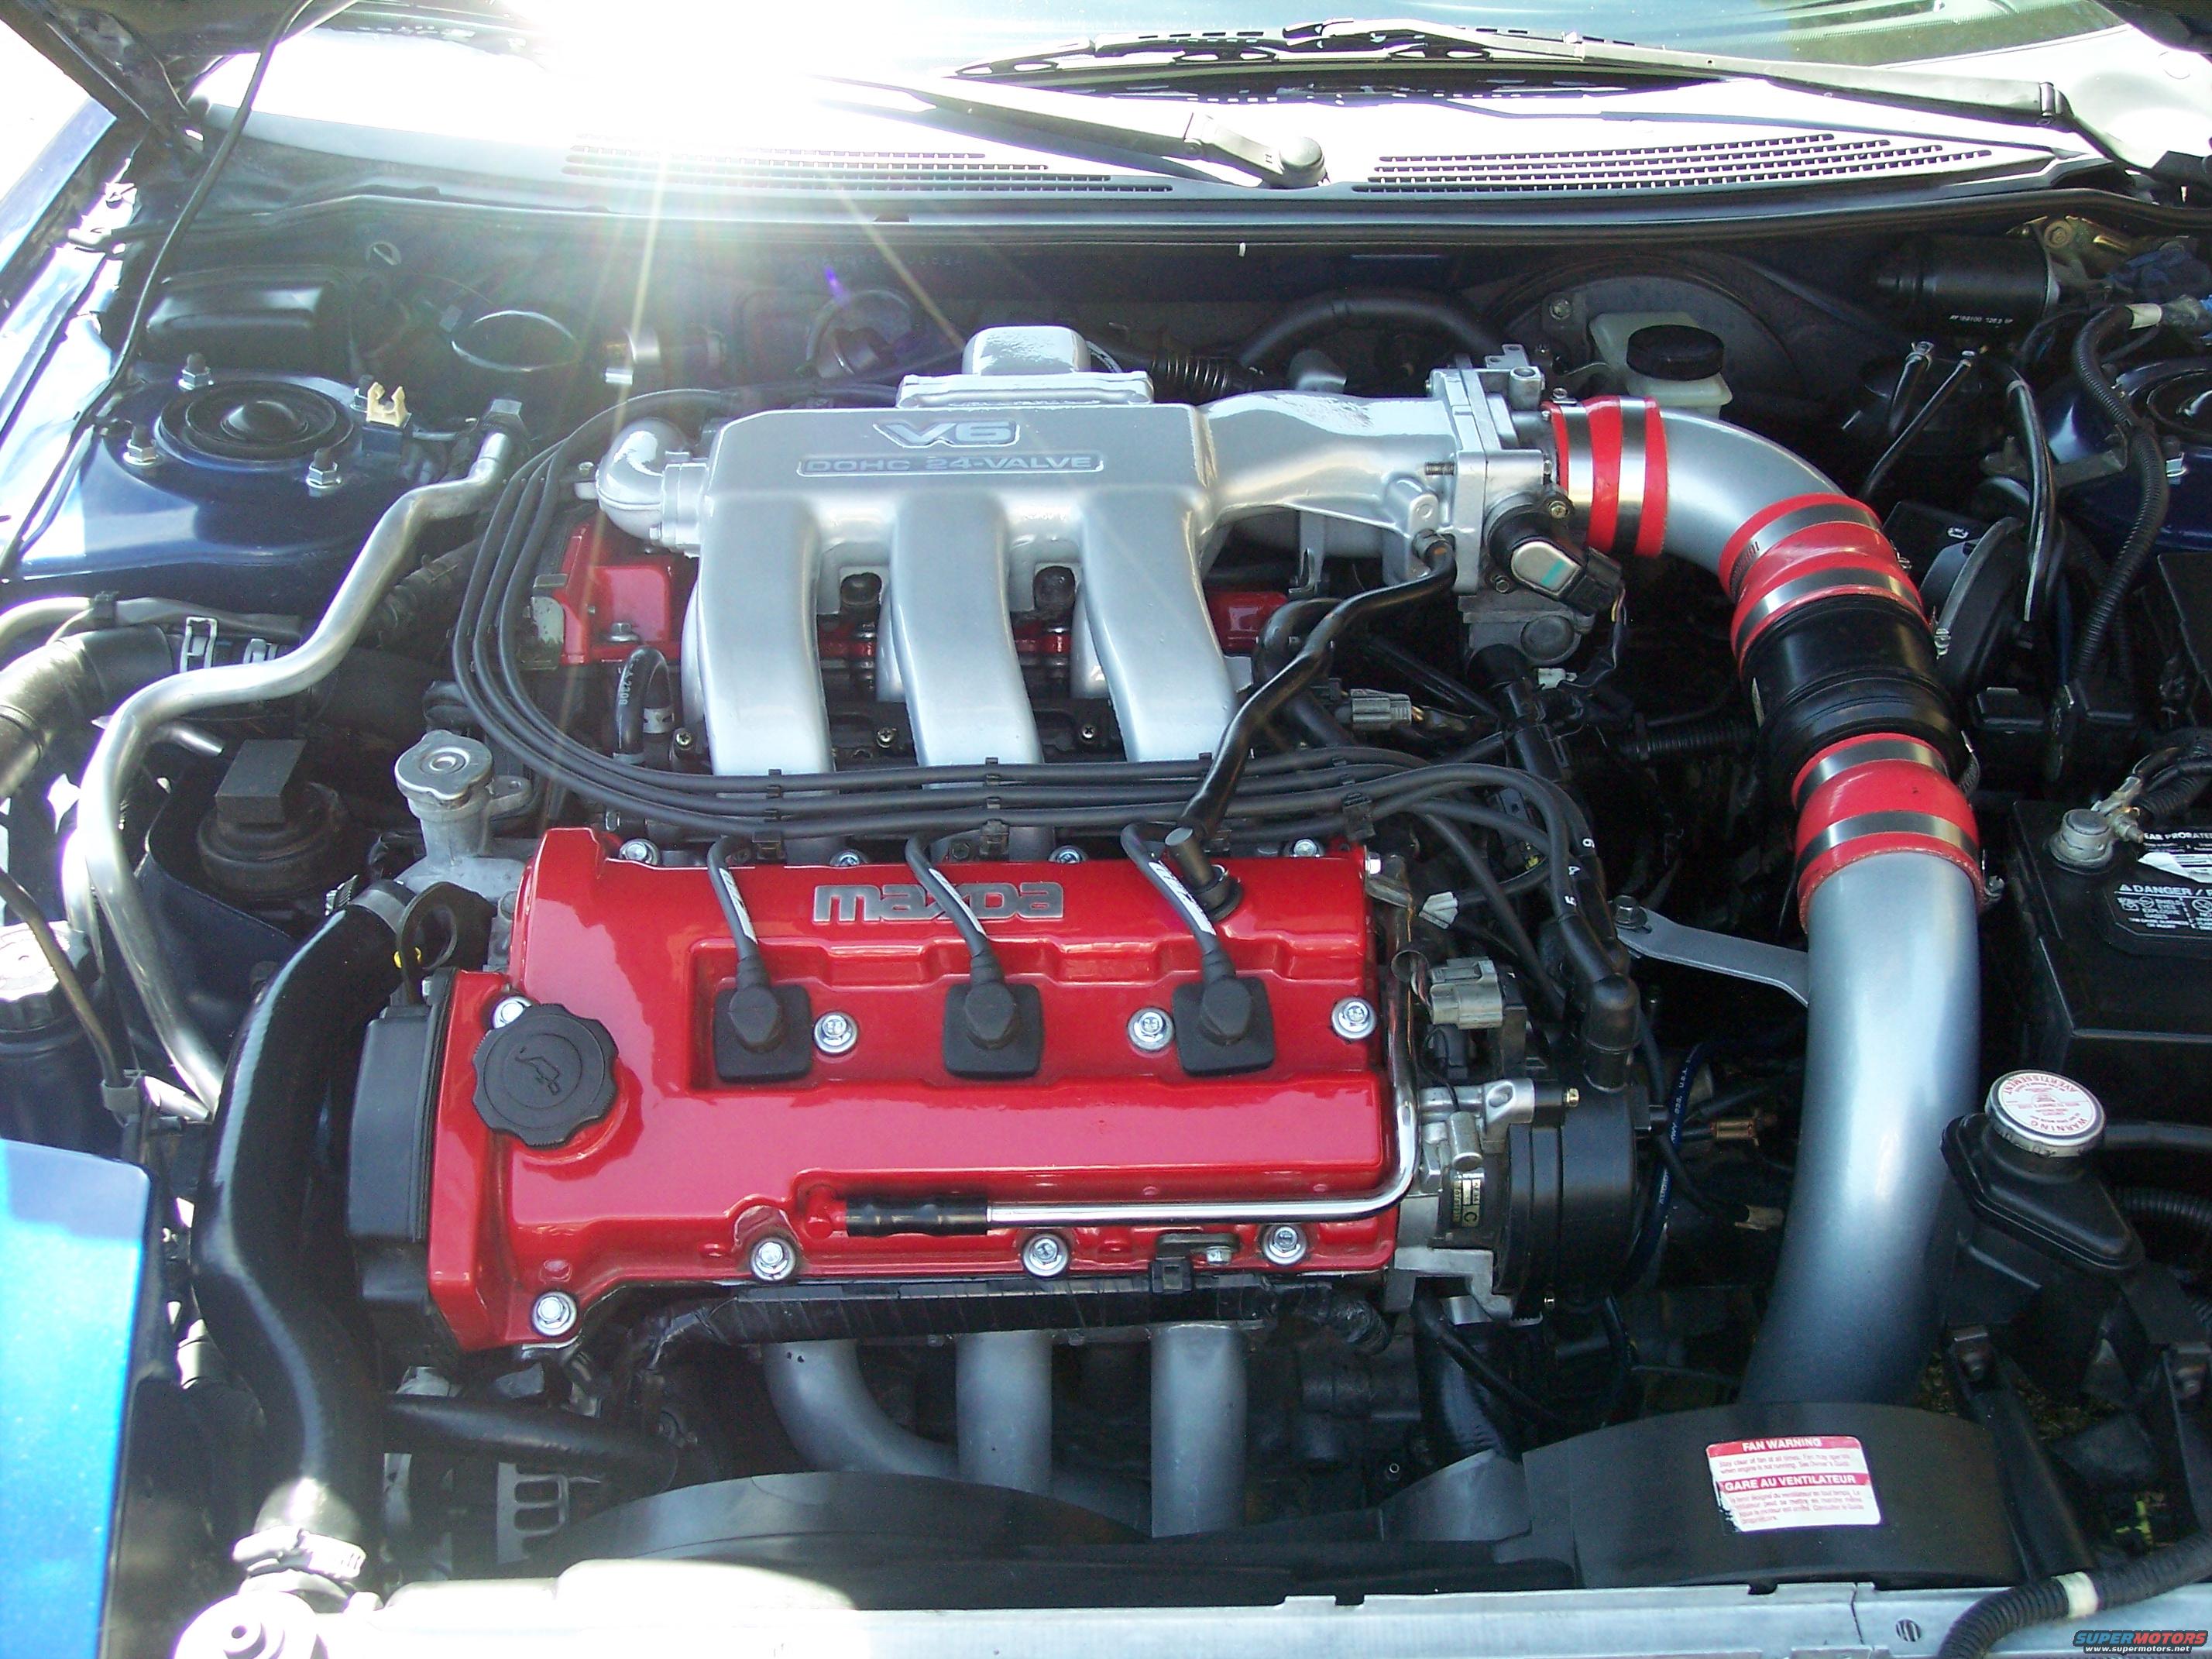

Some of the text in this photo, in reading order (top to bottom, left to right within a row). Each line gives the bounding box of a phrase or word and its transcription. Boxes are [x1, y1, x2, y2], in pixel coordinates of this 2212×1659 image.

[884, 421, 1013, 445] V6
[805, 456, 1092, 472] DOHC 24-VALVE
[2144, 831, 2212, 840] EAR PRORATE
[1582, 838, 1595, 849] 6
[2132, 884, 2193, 896] DANGER
[2031, 1118, 2088, 1132] WARNING
[1742, 1437, 1822, 1452] FAN WARNING
[1725, 1475, 1856, 1492] GARE AU VENTILATEUR
